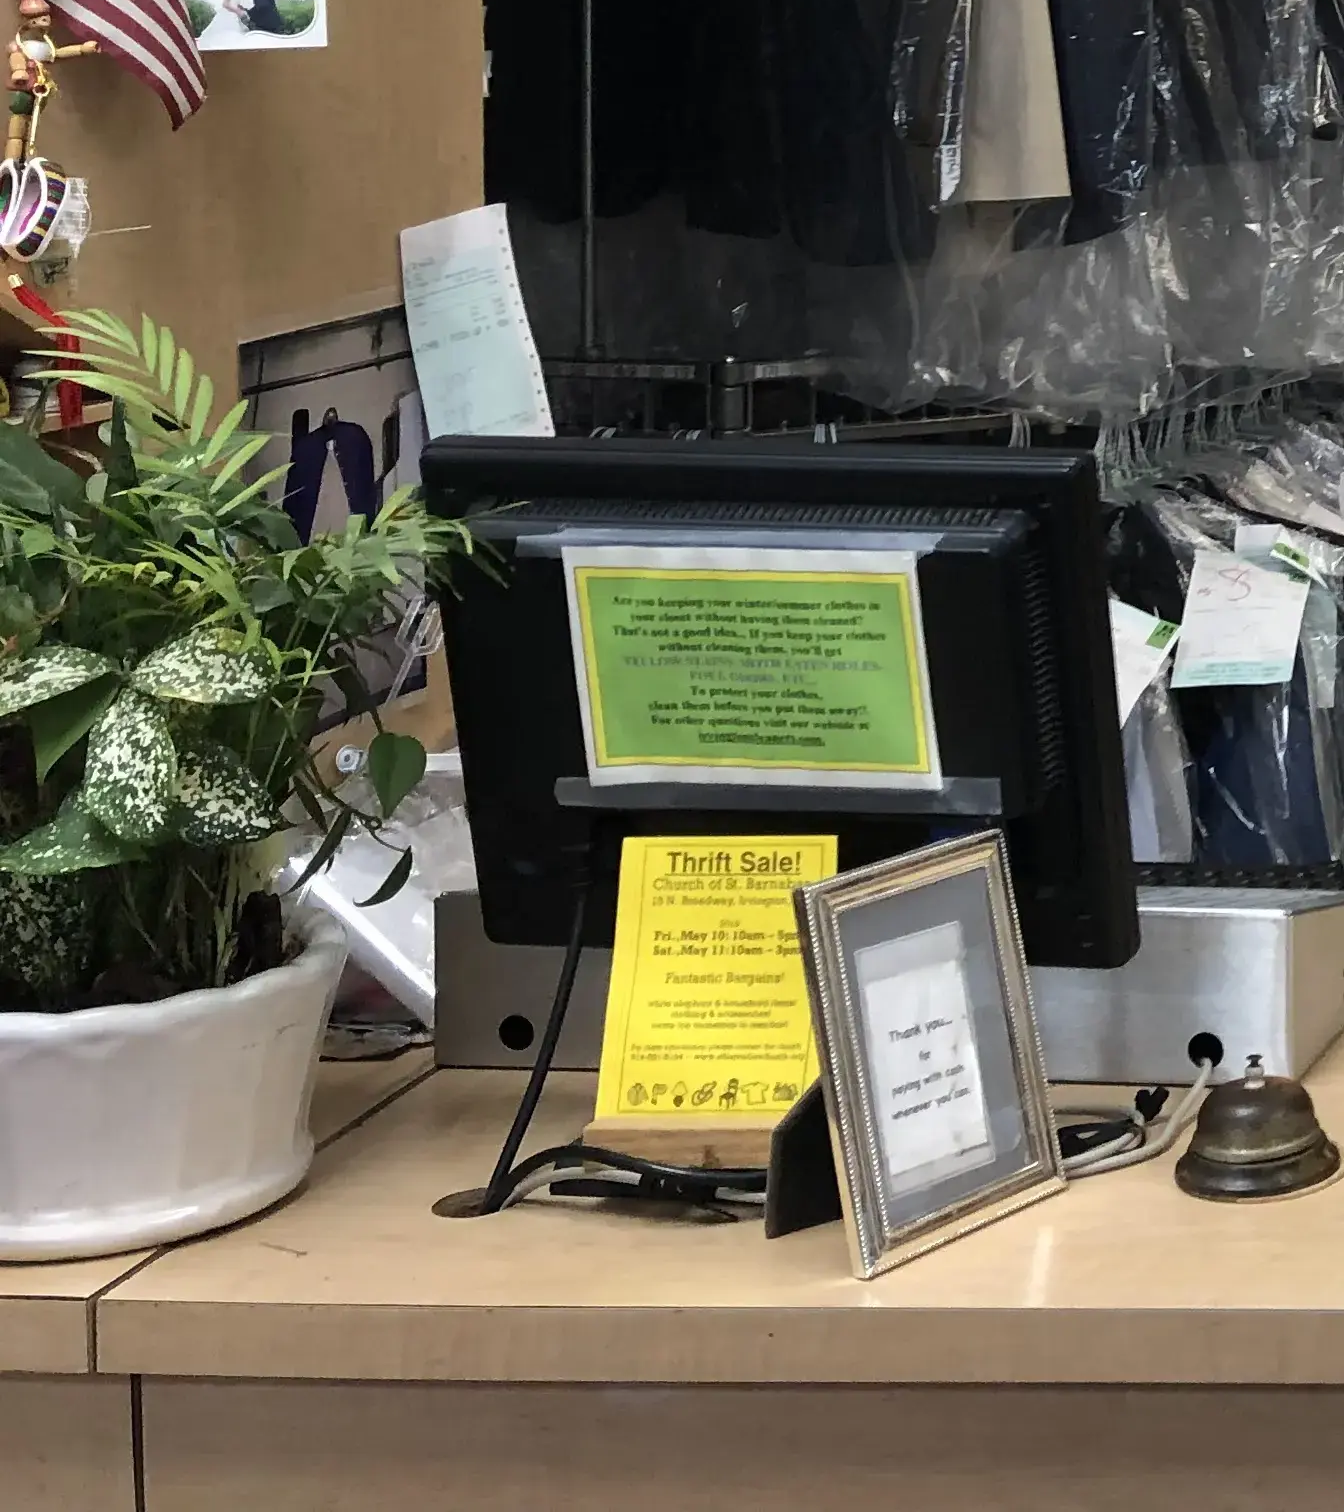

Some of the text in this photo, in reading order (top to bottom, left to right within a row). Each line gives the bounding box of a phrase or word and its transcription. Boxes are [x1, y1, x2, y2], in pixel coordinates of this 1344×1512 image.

[667, 851, 802, 874] Thrift Sale!
[653, 877, 704, 890] Church
[708, 877, 722, 890] of
[665, 972, 723, 984] Fantastic
[888, 1023, 921, 1043] Thank
